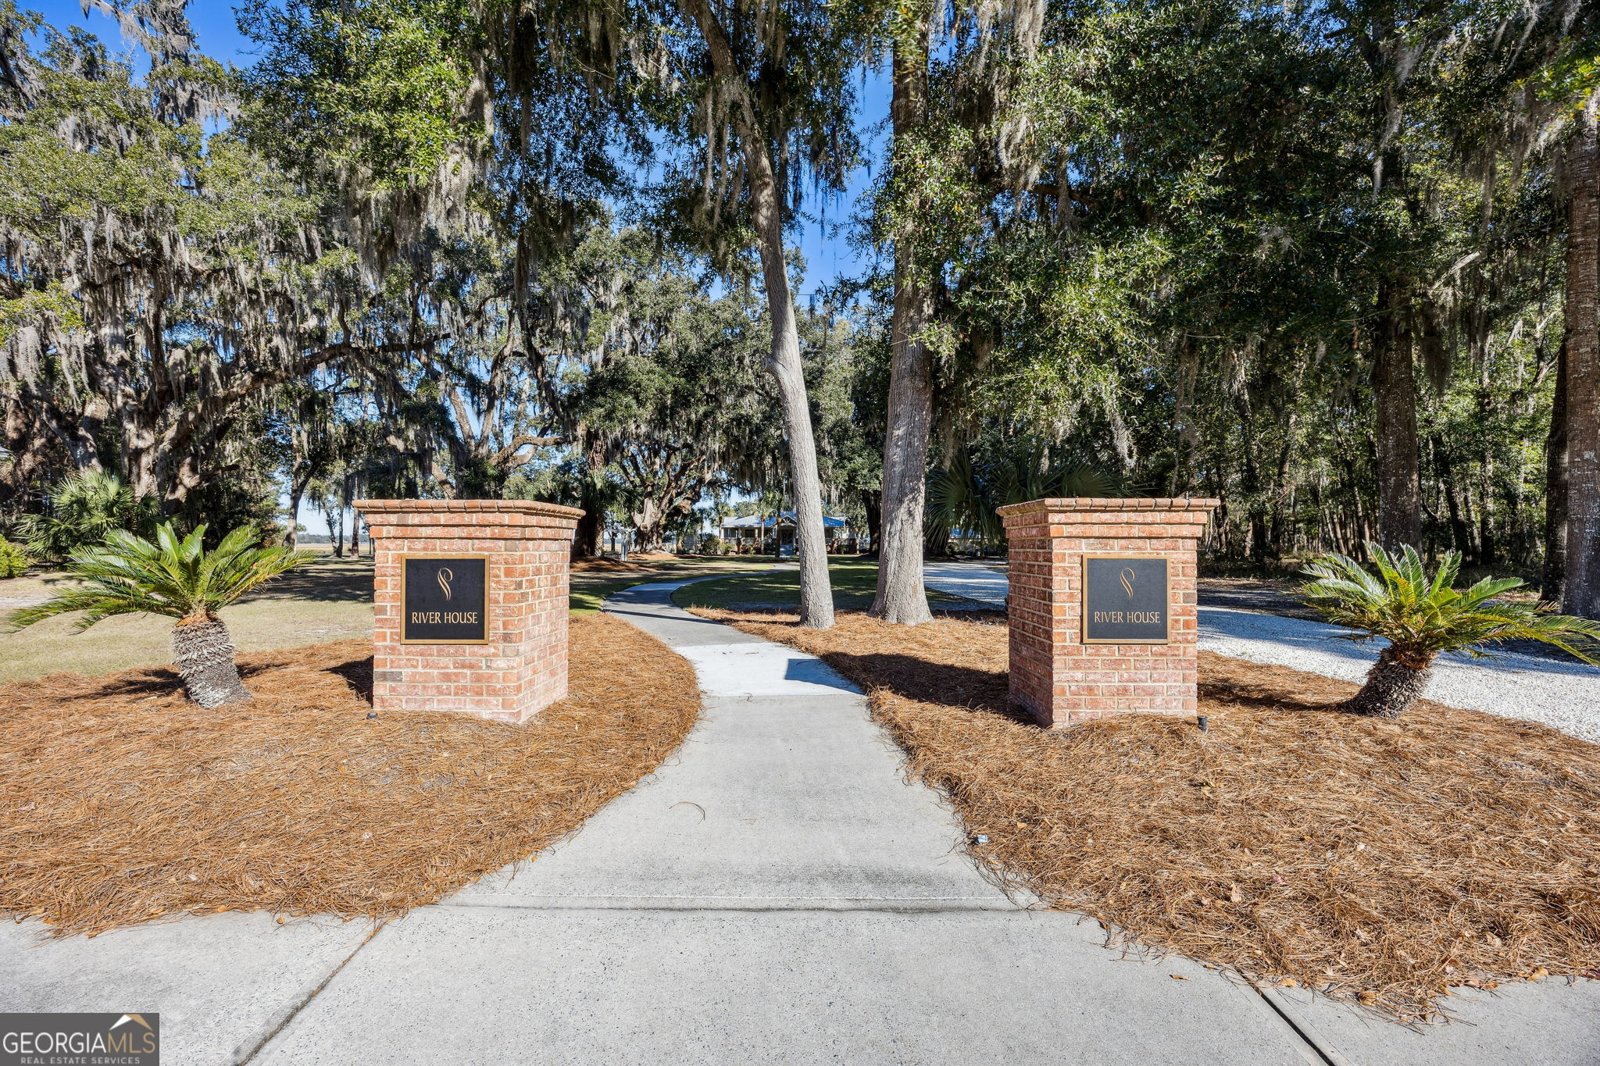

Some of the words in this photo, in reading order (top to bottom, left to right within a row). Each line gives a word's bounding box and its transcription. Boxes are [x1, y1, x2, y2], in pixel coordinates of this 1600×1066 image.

[411, 611, 442, 624] RIVER
[444, 611, 479, 624] HOUSE
[1094, 611, 1124, 624] RIVER
[1126, 611, 1161, 624] HOUSE
